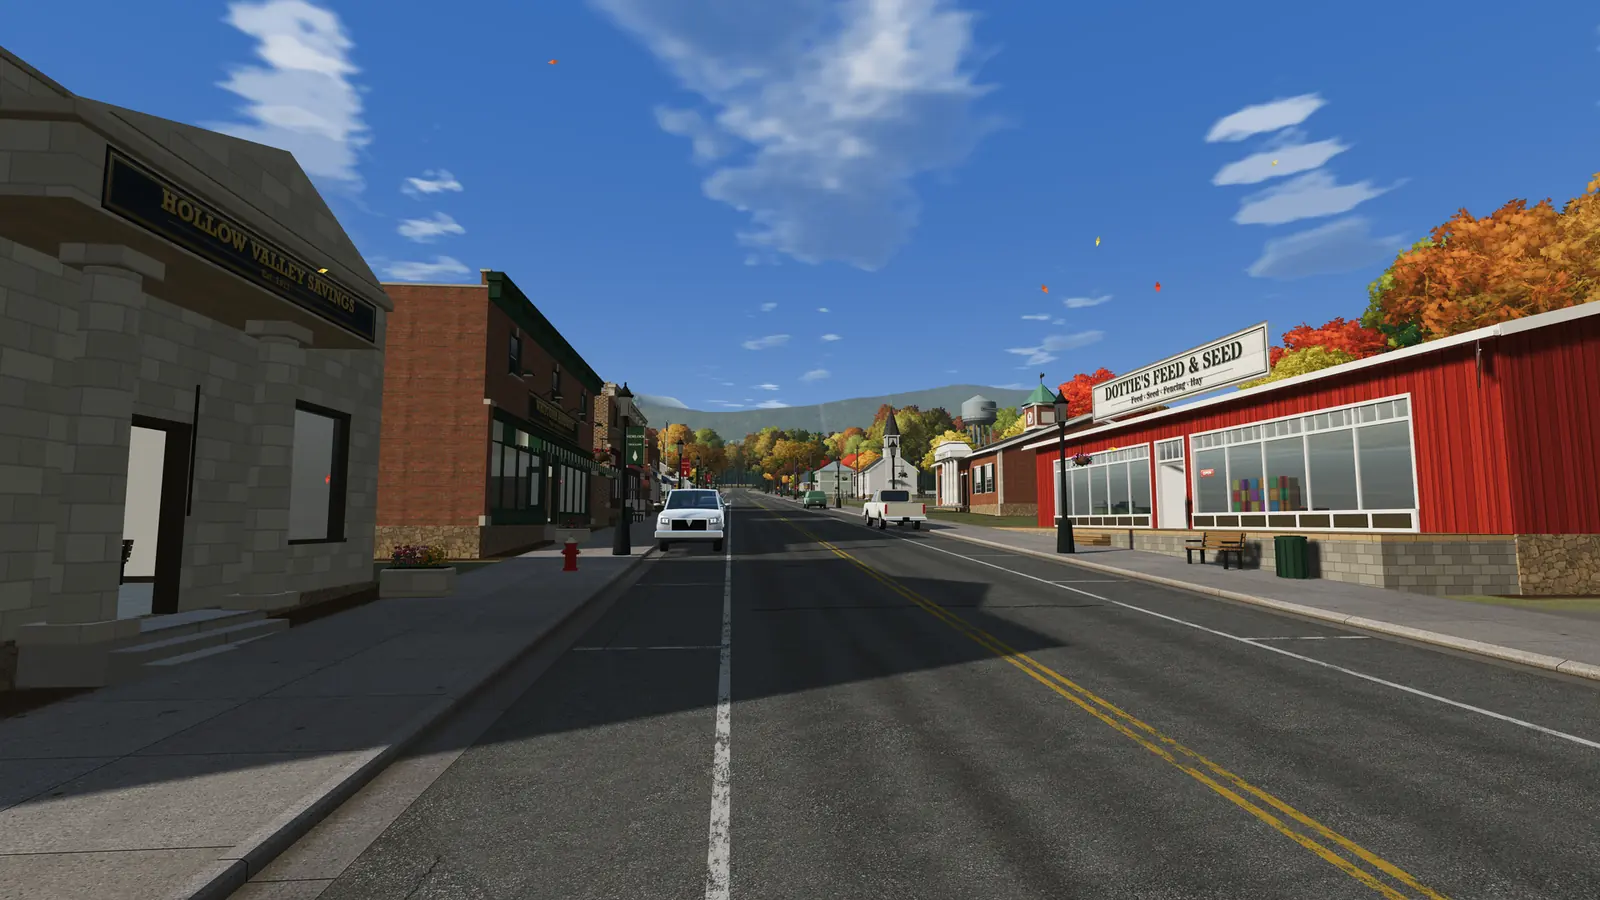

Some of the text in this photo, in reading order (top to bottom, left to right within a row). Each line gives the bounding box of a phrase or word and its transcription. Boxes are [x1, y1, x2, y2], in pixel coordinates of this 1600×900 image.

[161, 187, 355, 314] HOLLOW VALLEY SAVINGS
[1104, 340, 1243, 402] DOTTIE'S FEED & SEED
[1131, 375, 1204, 405] Feed Seed Fencing Hay
